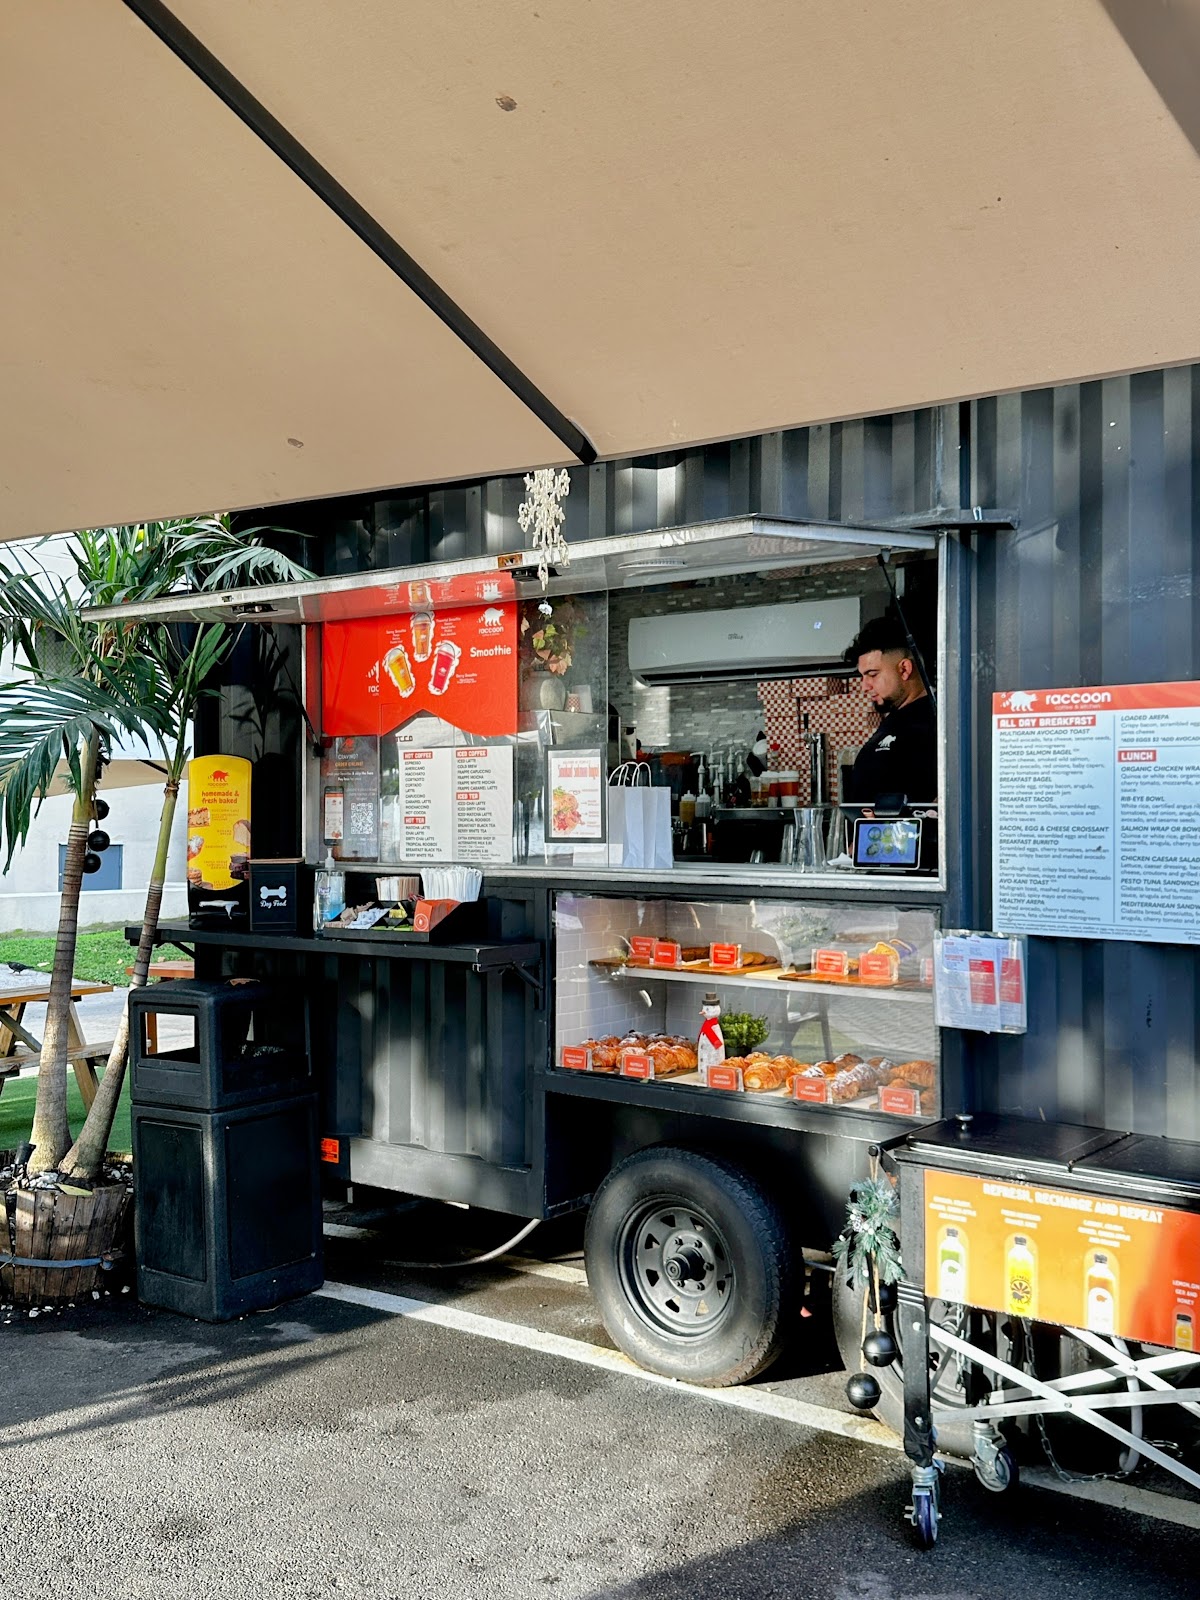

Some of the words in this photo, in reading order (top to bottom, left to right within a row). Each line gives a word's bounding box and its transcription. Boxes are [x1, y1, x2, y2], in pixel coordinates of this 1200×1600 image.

[470, 646, 511, 658] Smoothie
[1045, 692, 1111, 705] raccoon
[1000, 719, 1016, 728] ALL
[1019, 718, 1037, 727] DAY
[1039, 717, 1094, 726] BREAKFAST
[1121, 752, 1153, 761] LUNCH
[260, 900, 272, 909] Dog
[983, 1183, 1034, 1203] REFRESH,
[1035, 1191, 1093, 1212] RECHARGE
[1094, 1201, 1118, 1216] AND
[1120, 1206, 1164, 1224] REPEAT
